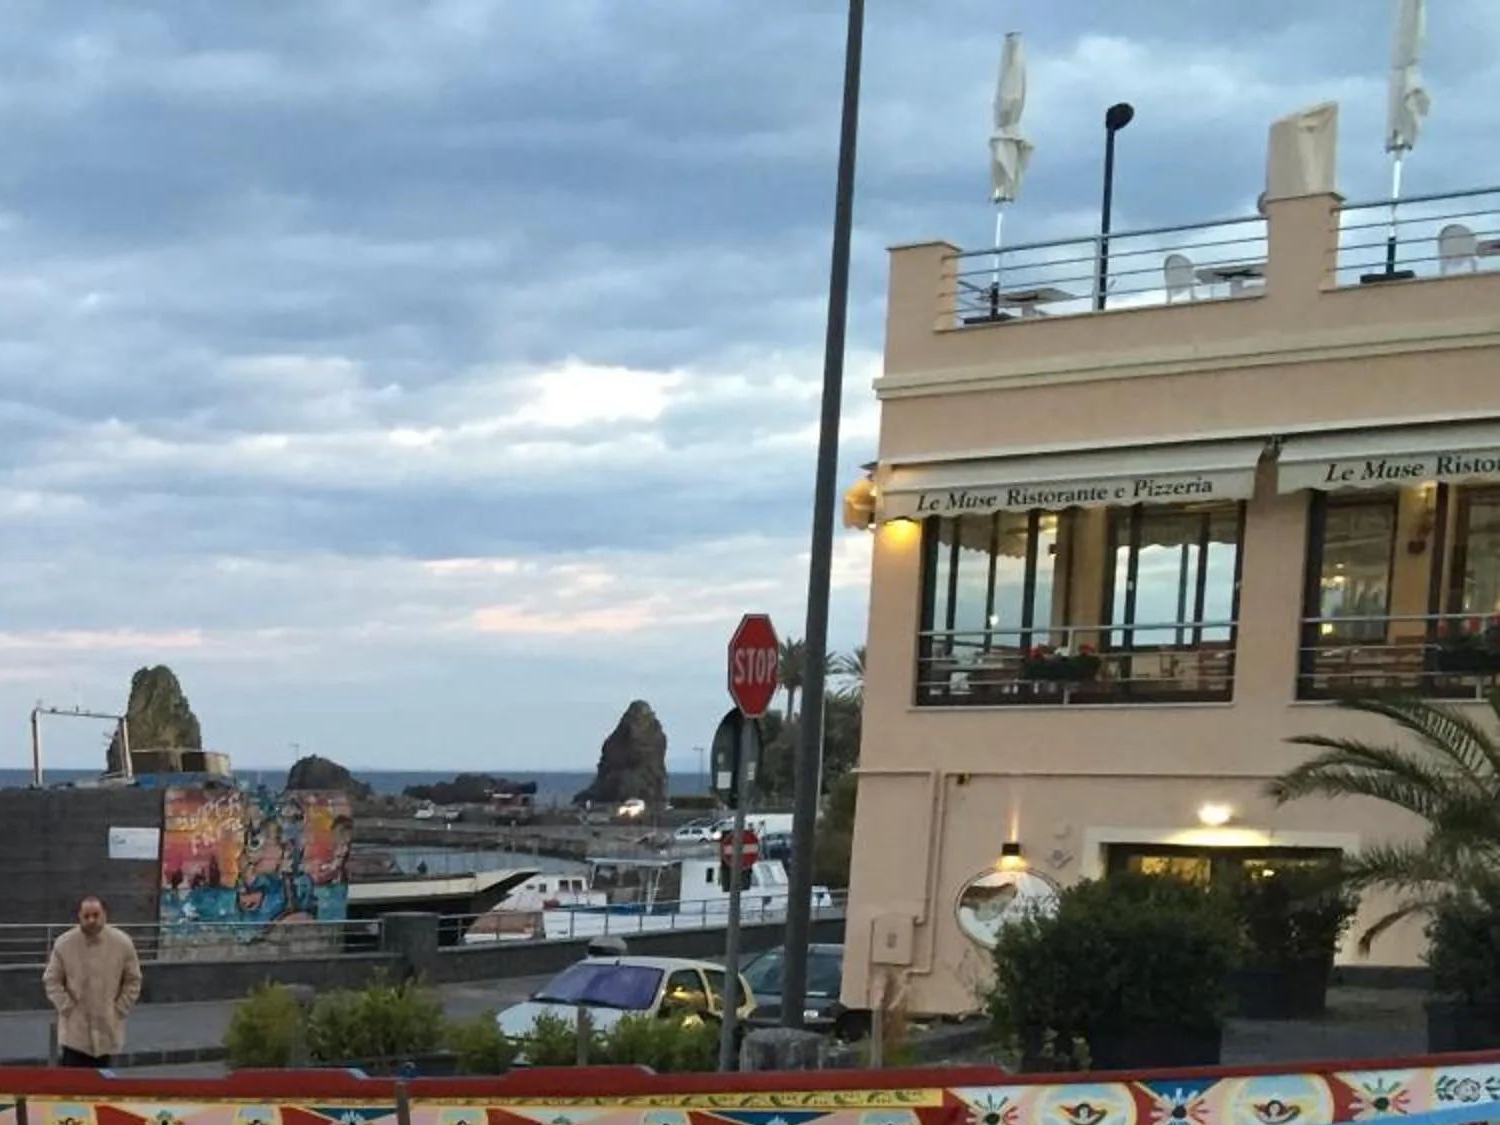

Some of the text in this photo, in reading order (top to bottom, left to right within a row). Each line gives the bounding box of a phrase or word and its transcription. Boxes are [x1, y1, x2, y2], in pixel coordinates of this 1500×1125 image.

[1324, 462, 1355, 483] Le
[1360, 459, 1425, 481] Muse
[917, 476, 1214, 513] Le Muse Ristorante e Pizzeria
[734, 647, 777, 685] STOP
